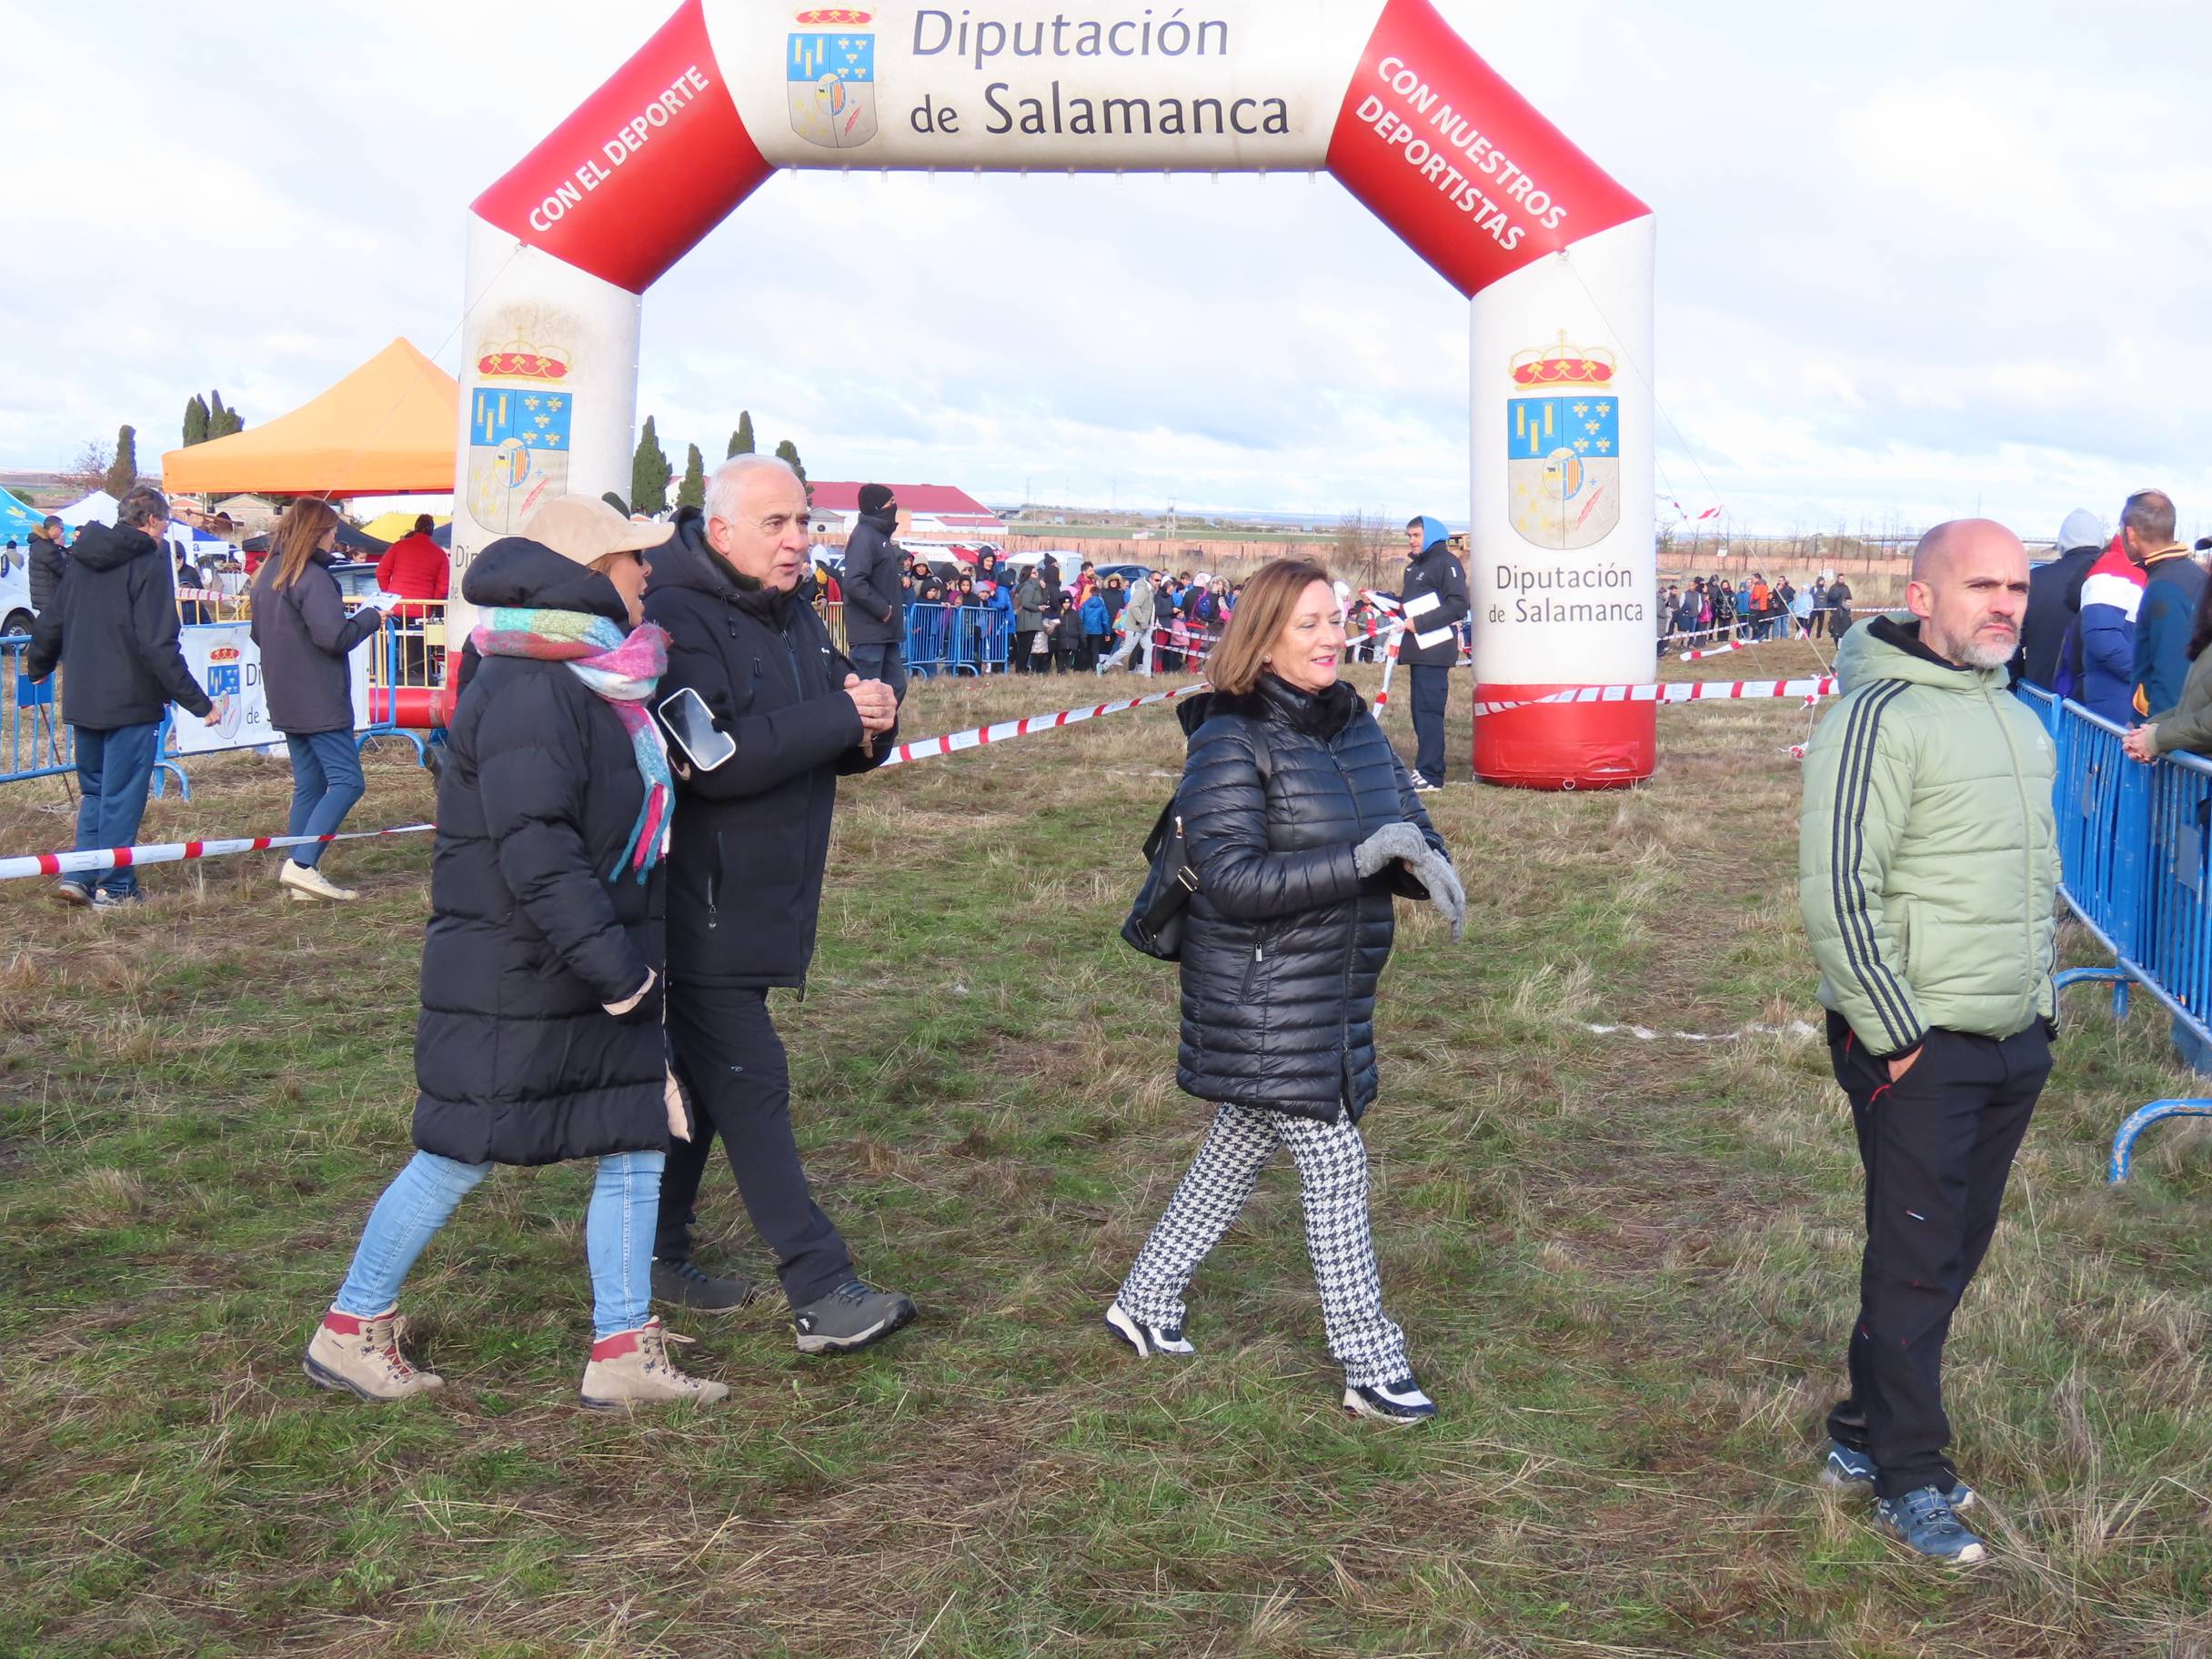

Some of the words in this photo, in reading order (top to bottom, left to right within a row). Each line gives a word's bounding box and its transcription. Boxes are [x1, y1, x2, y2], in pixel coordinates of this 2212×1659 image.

[910, 8, 1229, 70] Diputación
[910, 94, 960, 134] de
[984, 80, 1291, 136] Salamanca
[528, 181, 583, 233] CON
[575, 160, 611, 192] EL
[602, 65, 710, 166] DEPORTE
[1377, 56, 1438, 114] CON
[1430, 105, 1567, 229] NUESTROS
[1355, 95, 1525, 251] DEPORTISTAS
[1496, 562, 1633, 595] Diputación
[1488, 604, 1505, 623] de
[1515, 598, 1644, 623] Salamanca
[246, 707, 260, 725] de
